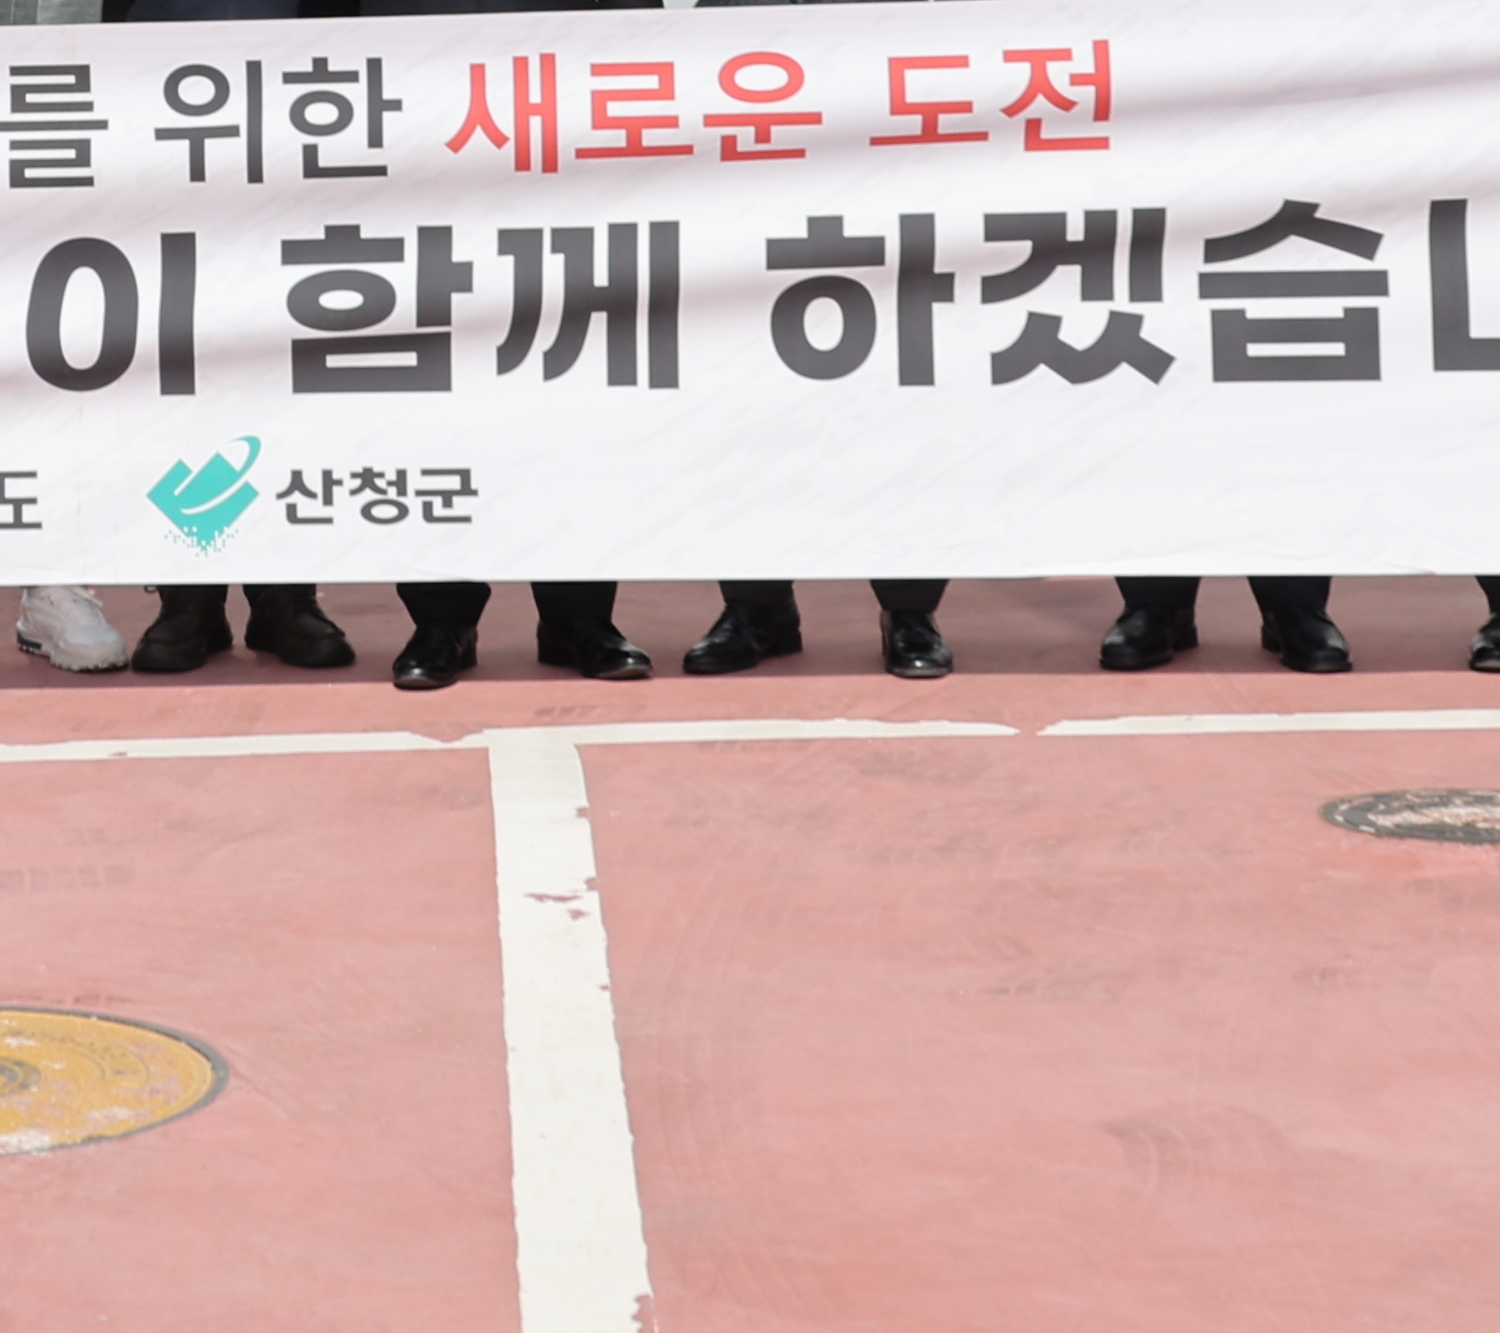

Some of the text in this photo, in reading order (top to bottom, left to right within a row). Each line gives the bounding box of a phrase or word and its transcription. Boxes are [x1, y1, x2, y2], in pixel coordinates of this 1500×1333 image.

[154, 56, 403, 185] 위한
[445, 51, 823, 175] 새로운
[868, 39, 1112, 152] 도전
[281, 221, 680, 393] 함께
[276, 467, 478, 525] 산청군
